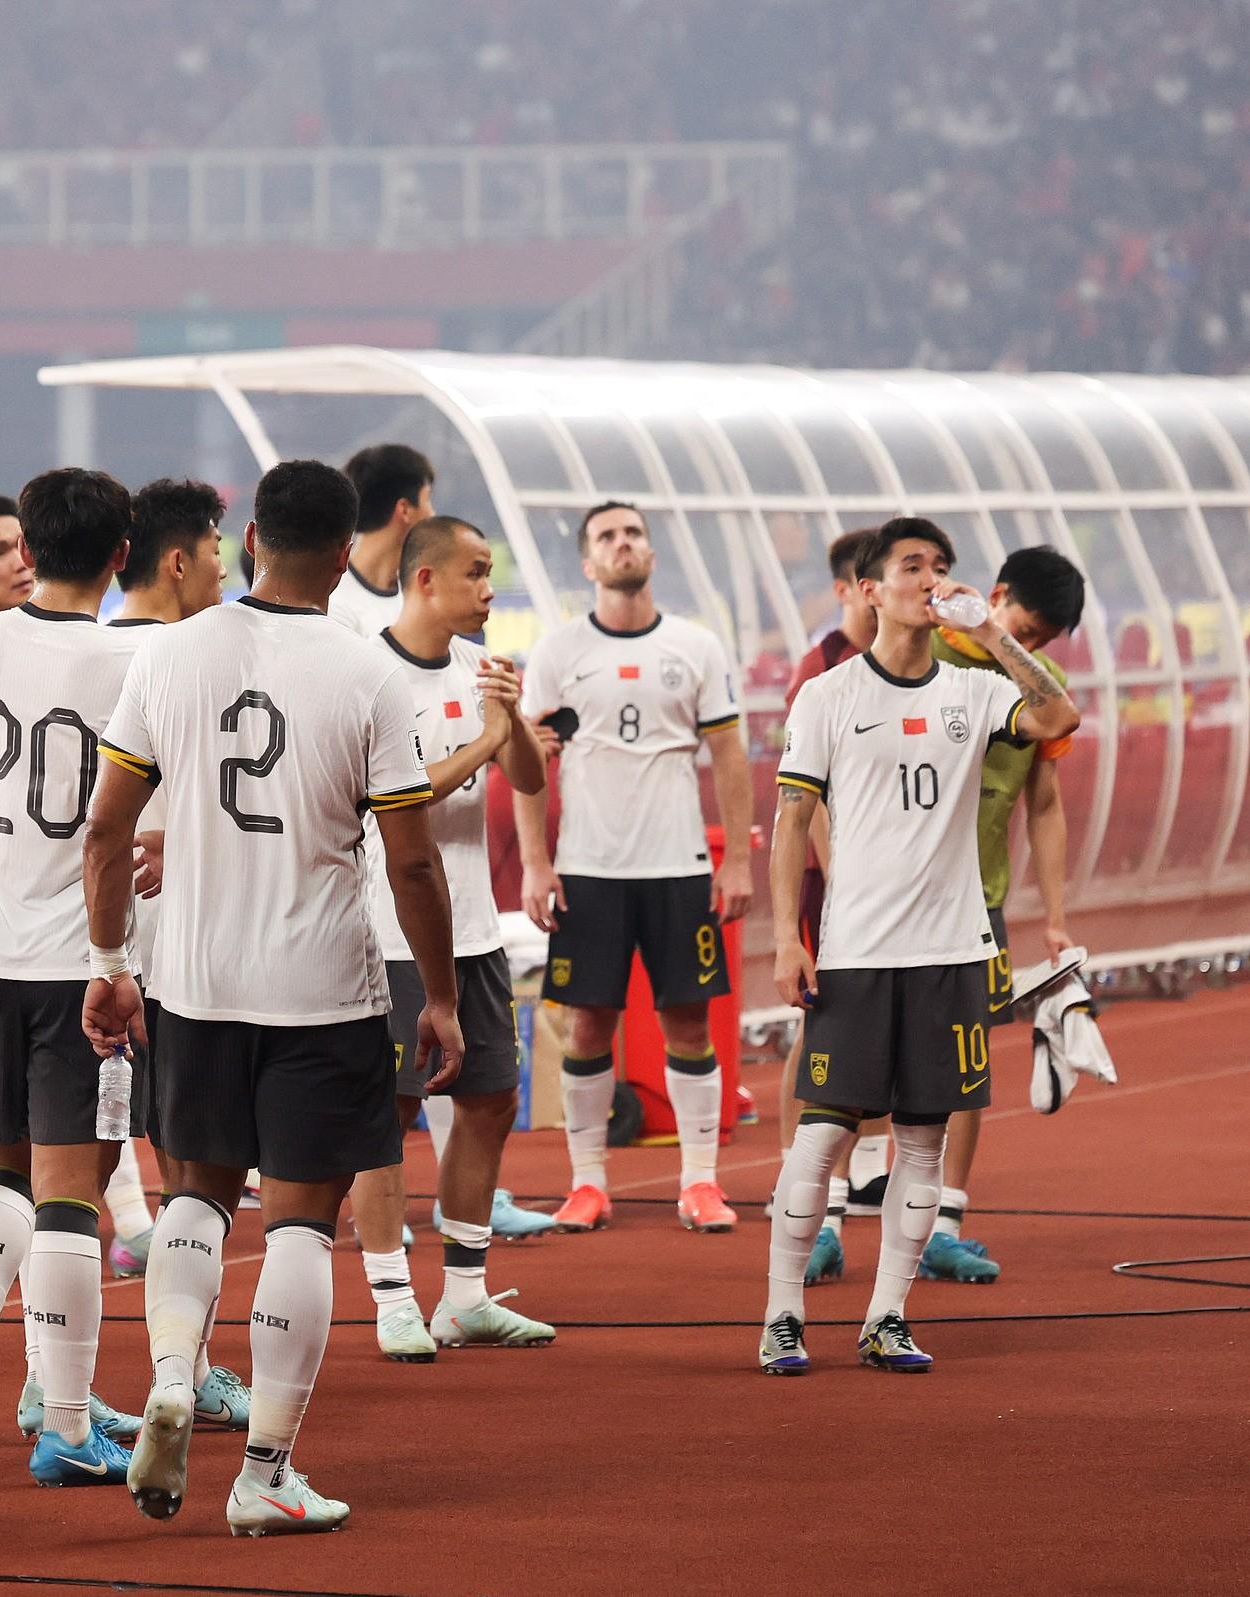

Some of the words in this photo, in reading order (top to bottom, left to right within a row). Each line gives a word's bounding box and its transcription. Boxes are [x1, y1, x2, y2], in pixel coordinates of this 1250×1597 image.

[620, 704, 639, 742] 8
[220, 690, 285, 834] 2
[899, 763, 938, 811] 10
[697, 925, 717, 967] 8
[988, 948, 1012, 994] 19
[952, 1022, 988, 1073] 10
[167, 1238, 212, 1256] 中国
[34, 1311, 66, 1326] 中国
[252, 1311, 290, 1331] 中国
